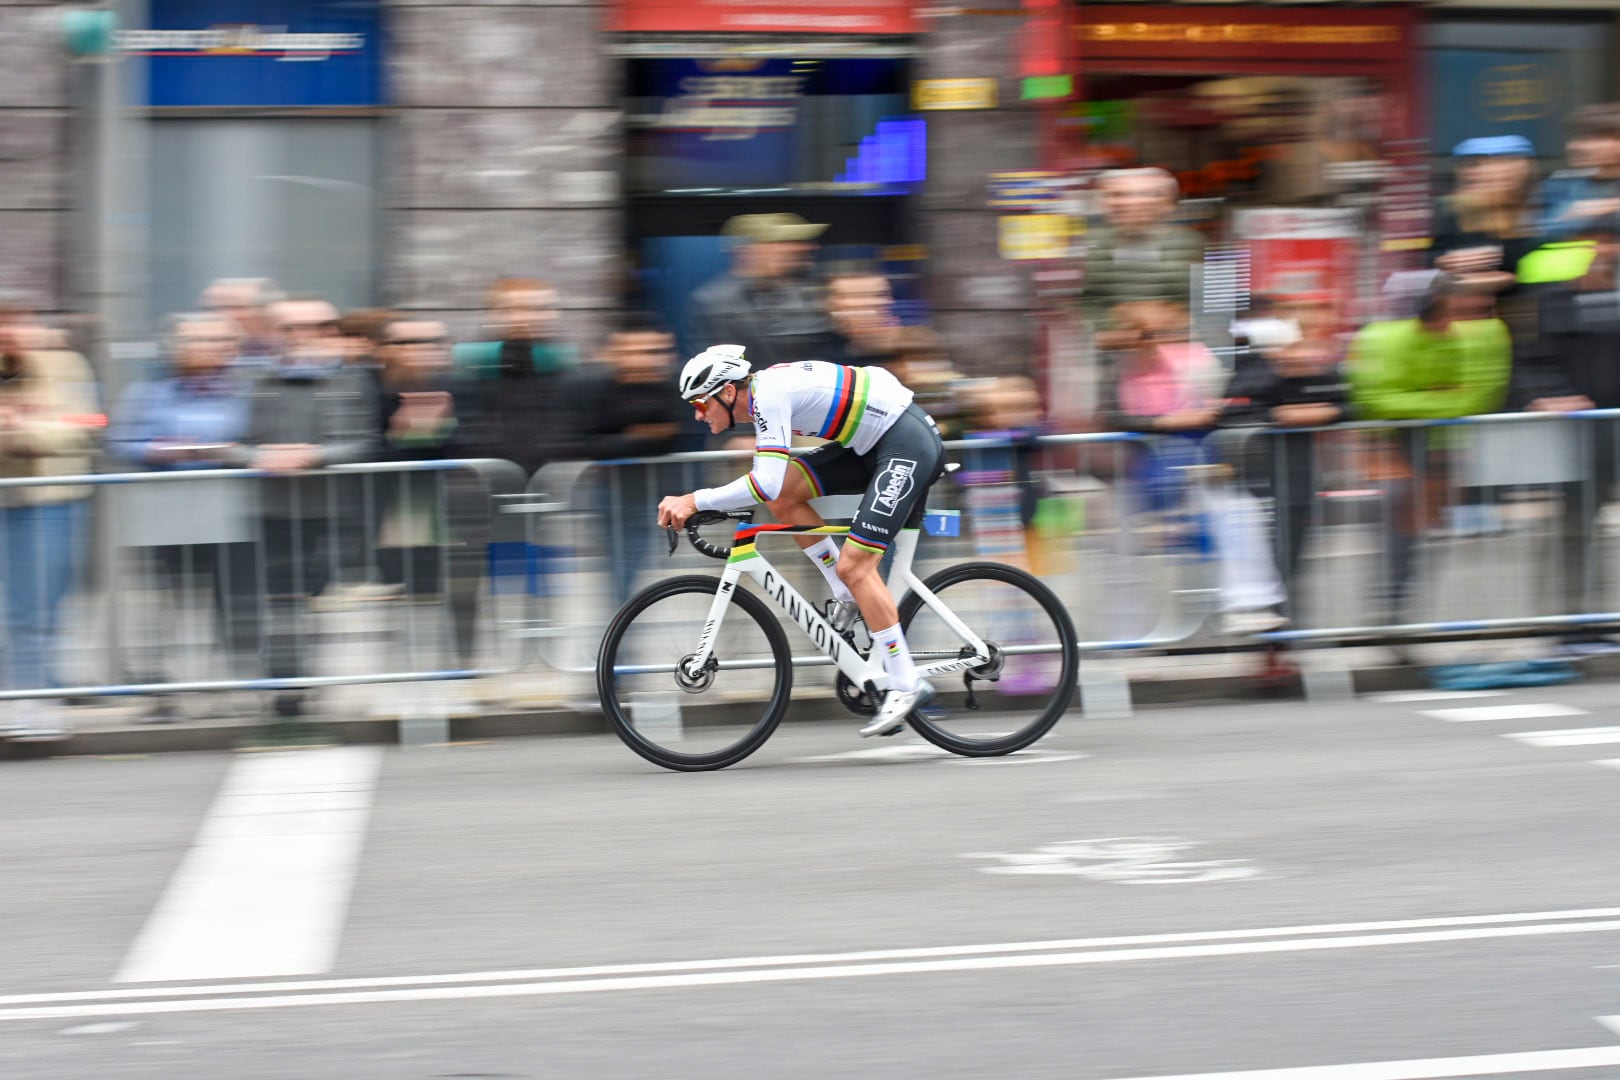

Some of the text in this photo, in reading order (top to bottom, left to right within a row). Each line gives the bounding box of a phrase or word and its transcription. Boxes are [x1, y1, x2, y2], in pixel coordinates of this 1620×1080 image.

[703, 365, 735, 389] CANYON
[878, 464, 910, 508] Alpecin
[940, 516, 948, 531] 1
[764, 571, 840, 662] CANYON
[927, 660, 974, 675] CANYON
